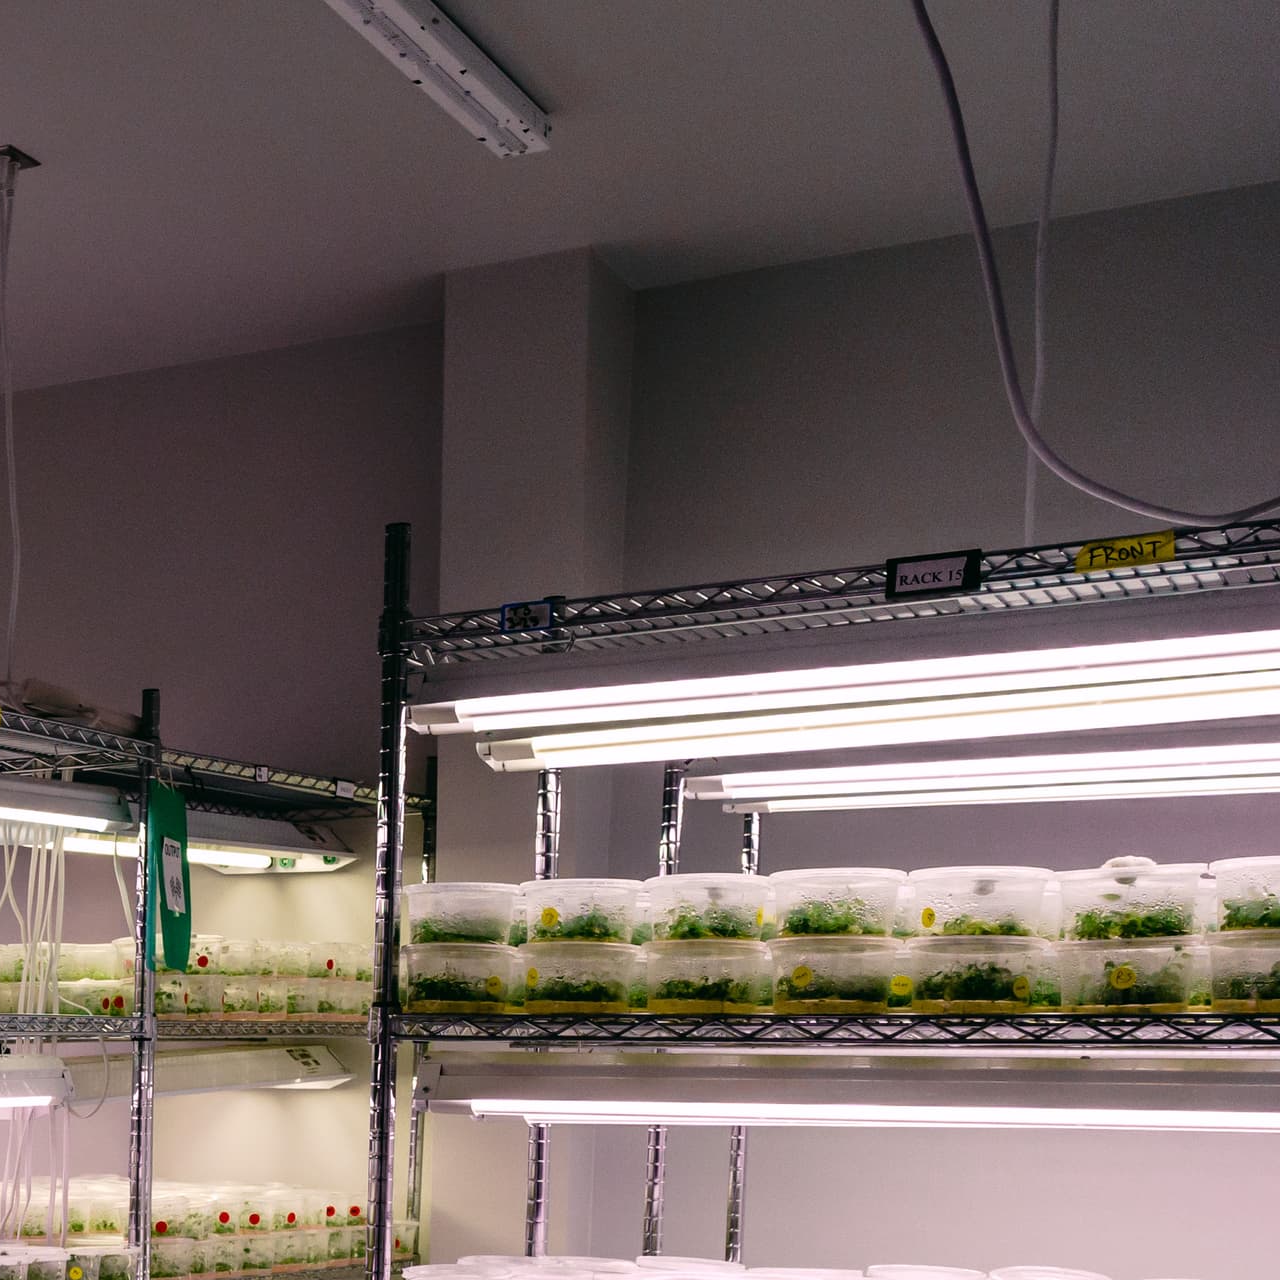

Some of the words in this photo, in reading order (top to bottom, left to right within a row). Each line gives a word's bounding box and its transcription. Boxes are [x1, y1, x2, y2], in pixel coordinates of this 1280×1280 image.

[1089, 540, 1162, 567] FRONT
[899, 570, 943, 586] RACK
[948, 568, 962, 582] 15
